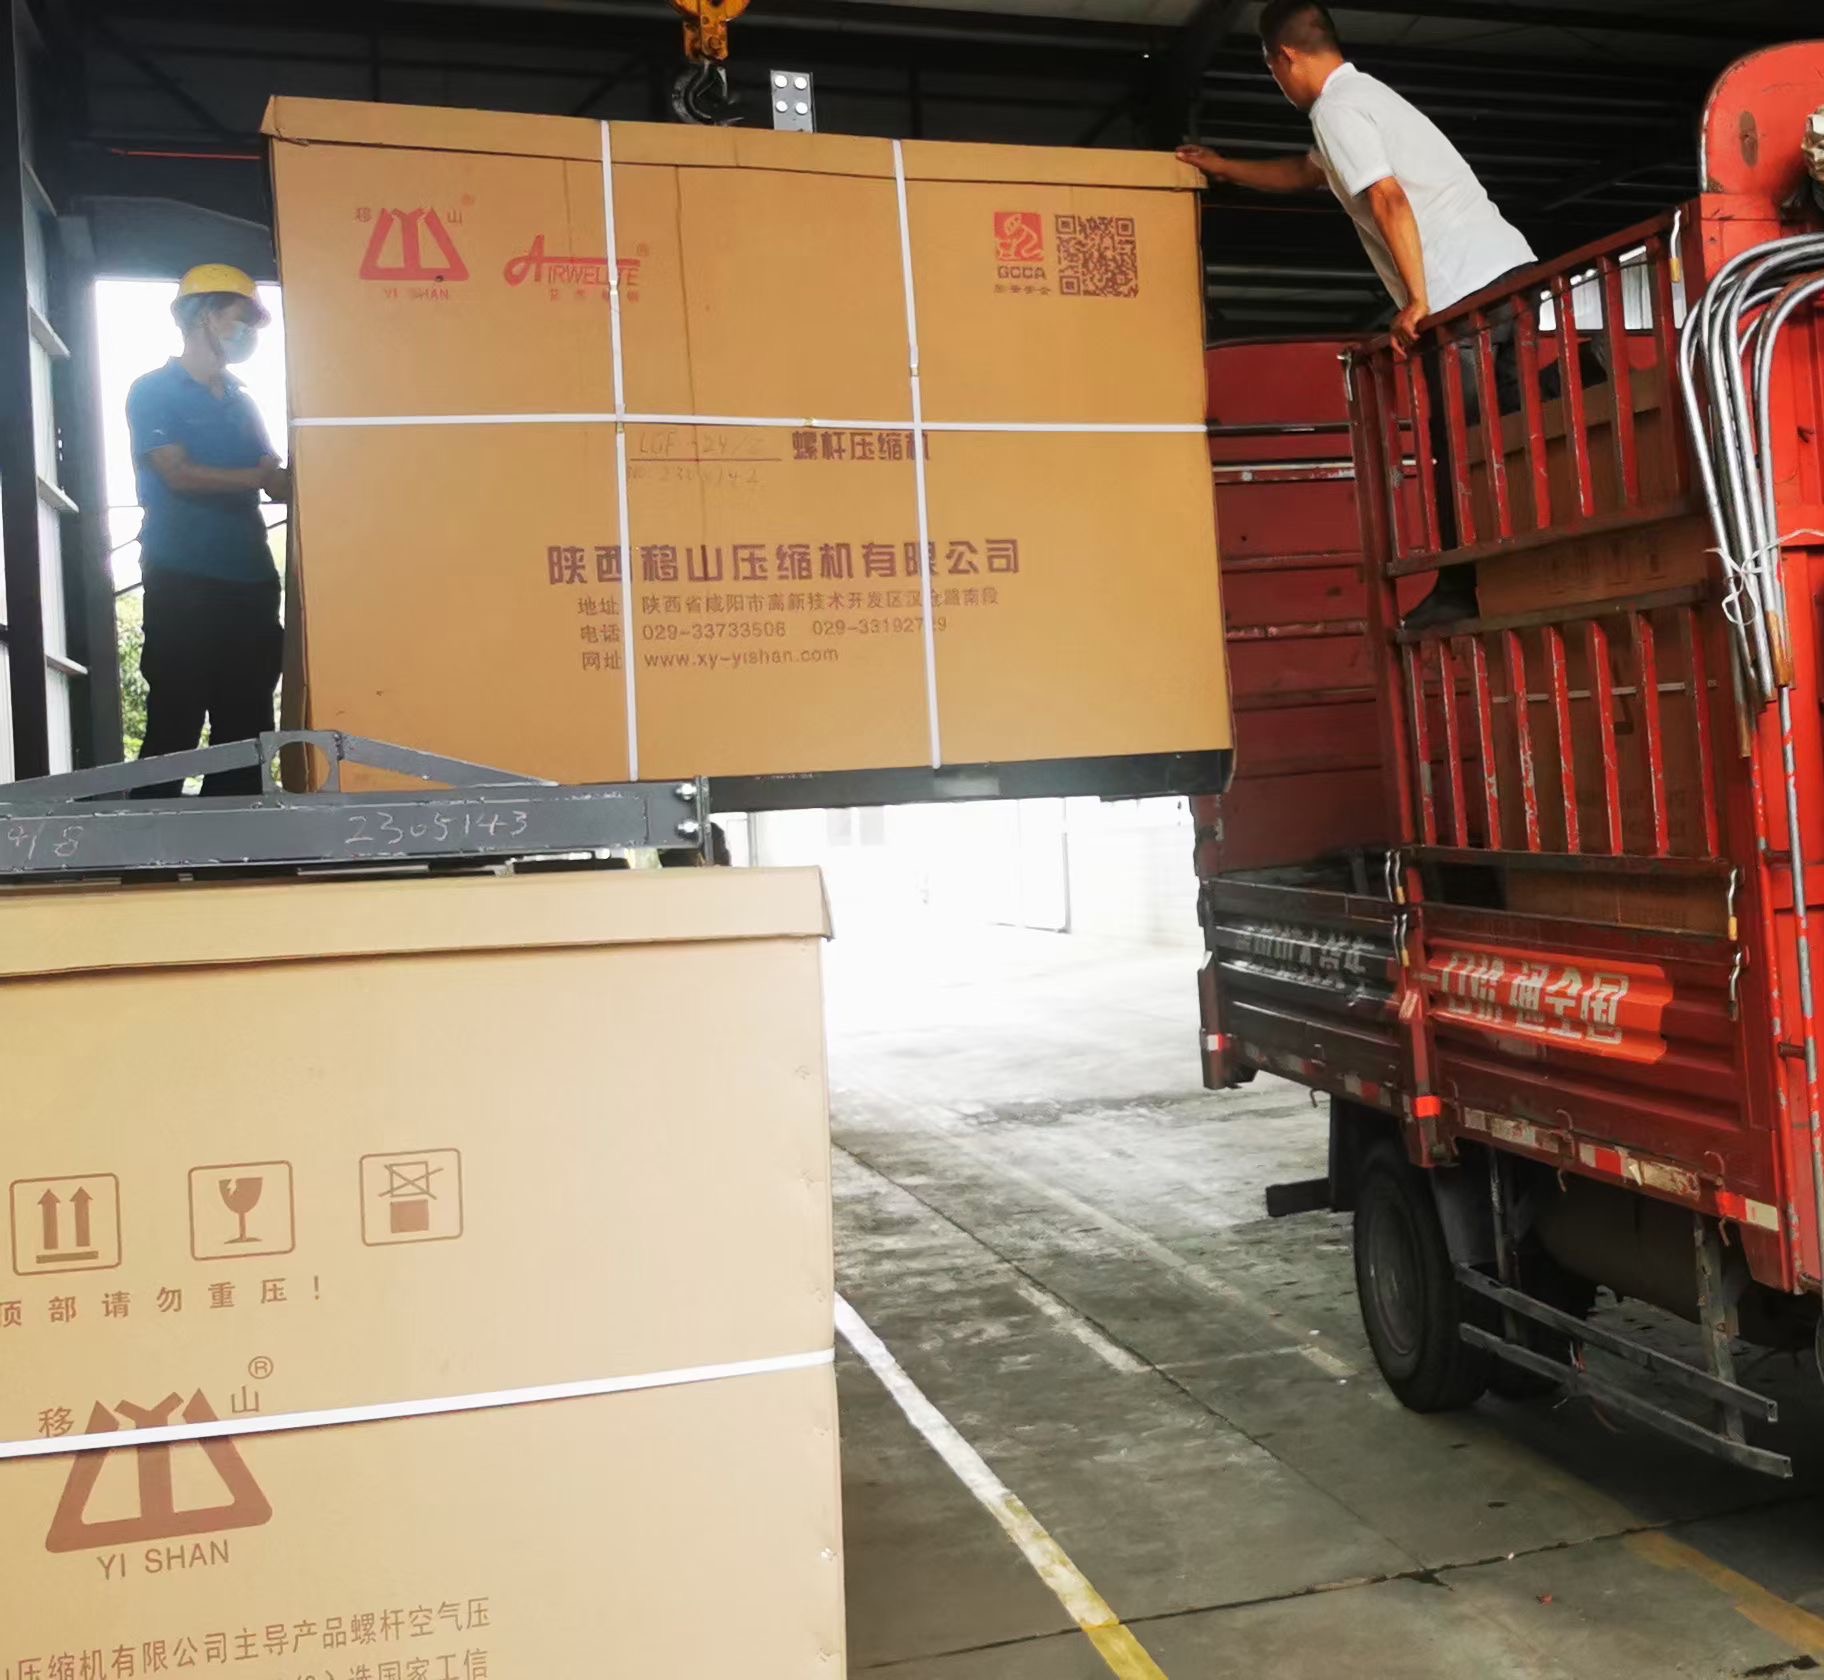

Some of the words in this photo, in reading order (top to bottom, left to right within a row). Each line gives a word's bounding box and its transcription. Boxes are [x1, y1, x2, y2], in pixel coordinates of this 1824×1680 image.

[546, 537, 1020, 585] 陕西移山压缩机有限公司
[643, 647, 840, 671] www.xy-yishan.com
[344, 810, 528, 845] 2305143
[37, 1405, 75, 1438] 移
[230, 1385, 260, 1414] 山
[96, 1552, 126, 1581] YI
[144, 1539, 230, 1574] SHAN
[5, 1596, 492, 1680] 压缩机有限公司主导产品螺杆空气压
